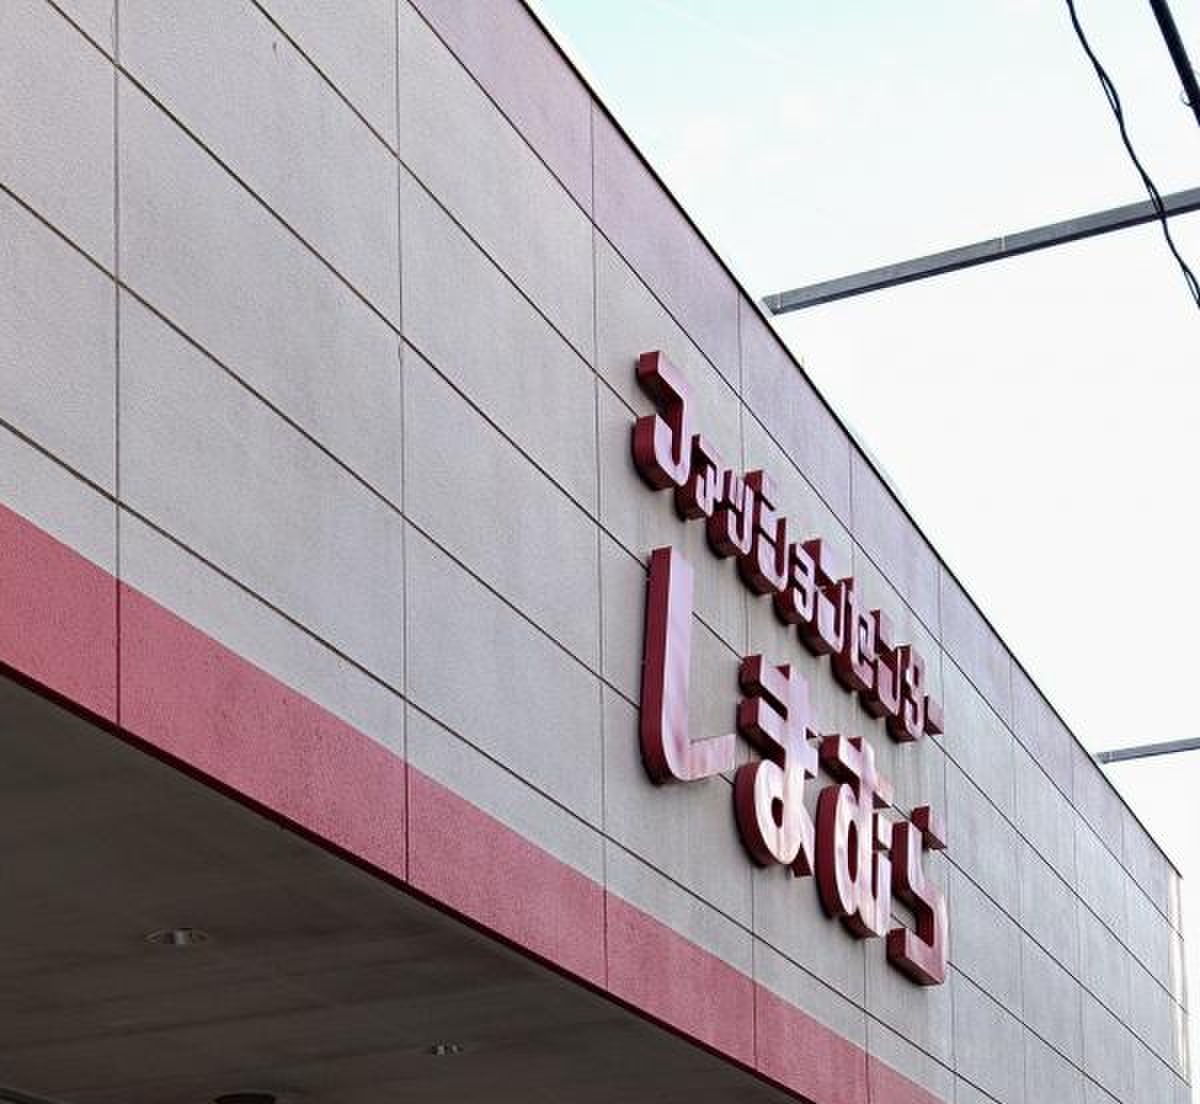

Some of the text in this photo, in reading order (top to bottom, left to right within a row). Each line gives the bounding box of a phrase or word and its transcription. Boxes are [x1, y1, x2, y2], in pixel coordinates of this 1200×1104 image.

[632, 350, 944, 743] ファッションセンター
[639, 545, 948, 986] しまむら
